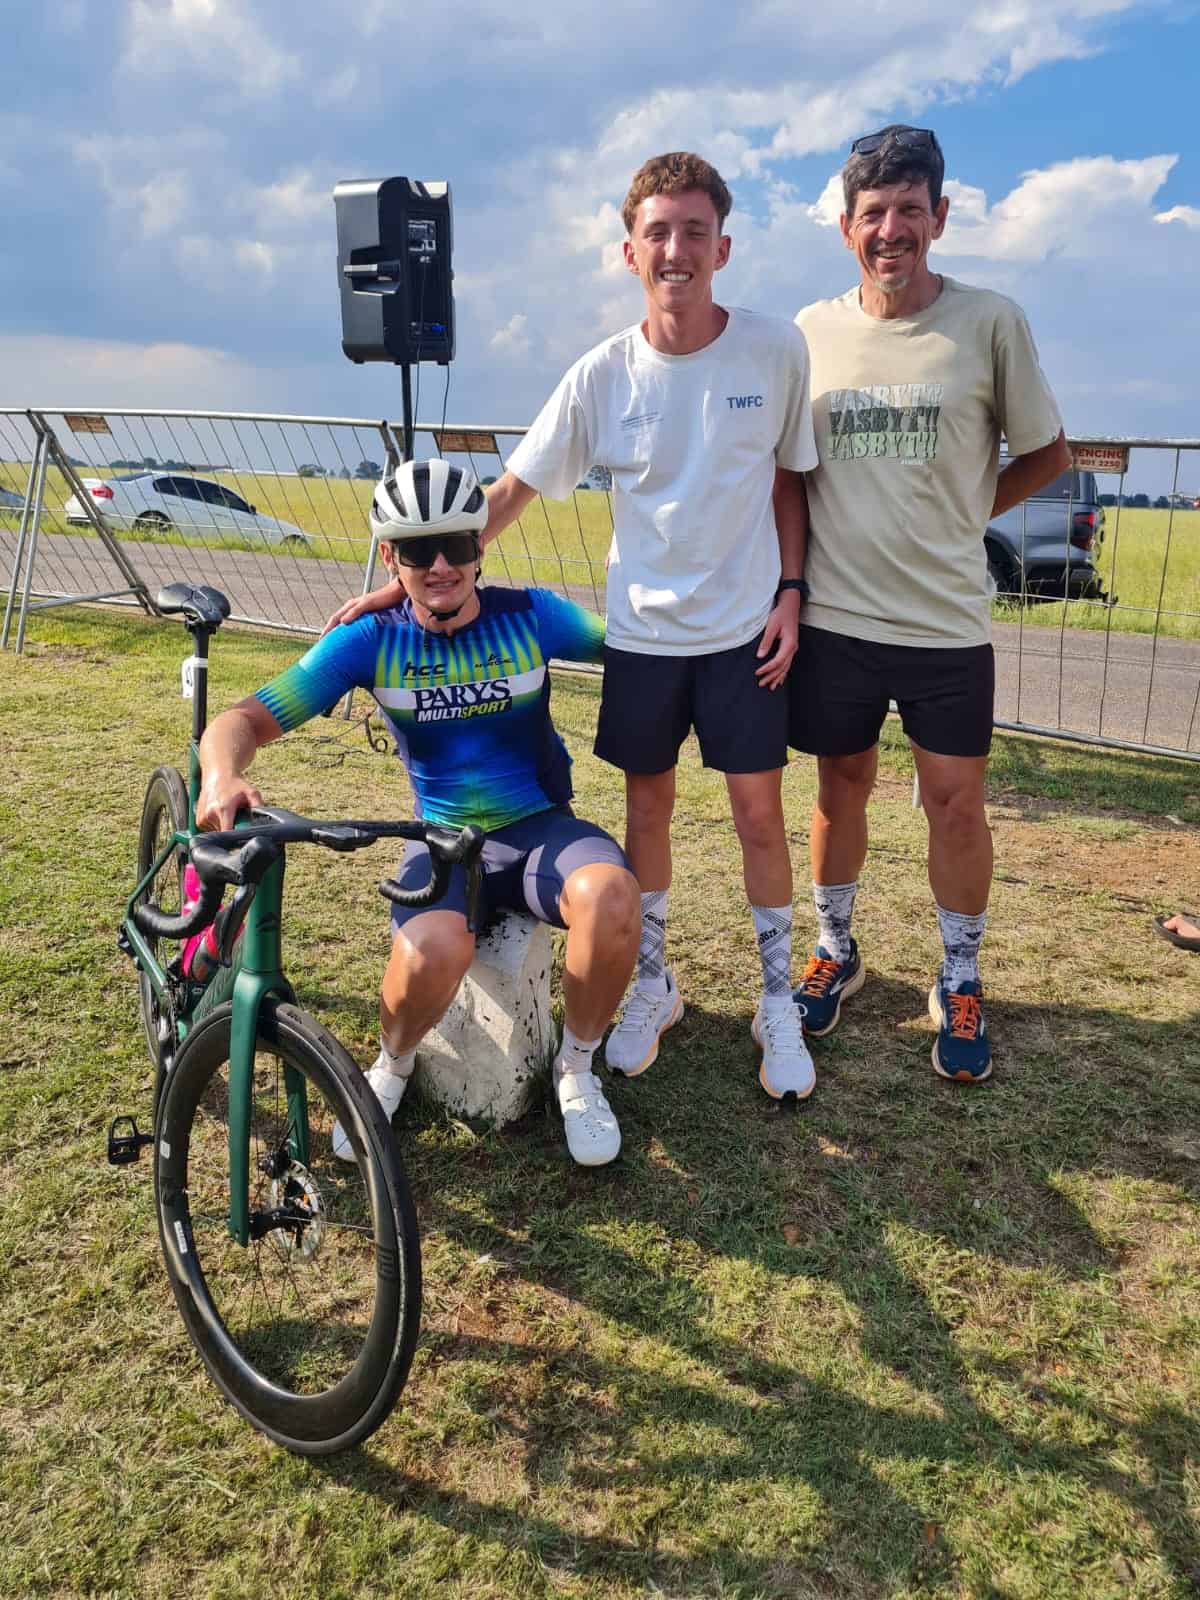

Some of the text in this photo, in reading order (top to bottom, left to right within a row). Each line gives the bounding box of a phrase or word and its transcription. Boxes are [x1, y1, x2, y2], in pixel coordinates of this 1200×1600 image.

[726, 395, 764, 409] TWFC
[403, 661, 447, 676] hcc
[411, 679, 511, 710] PARYS
